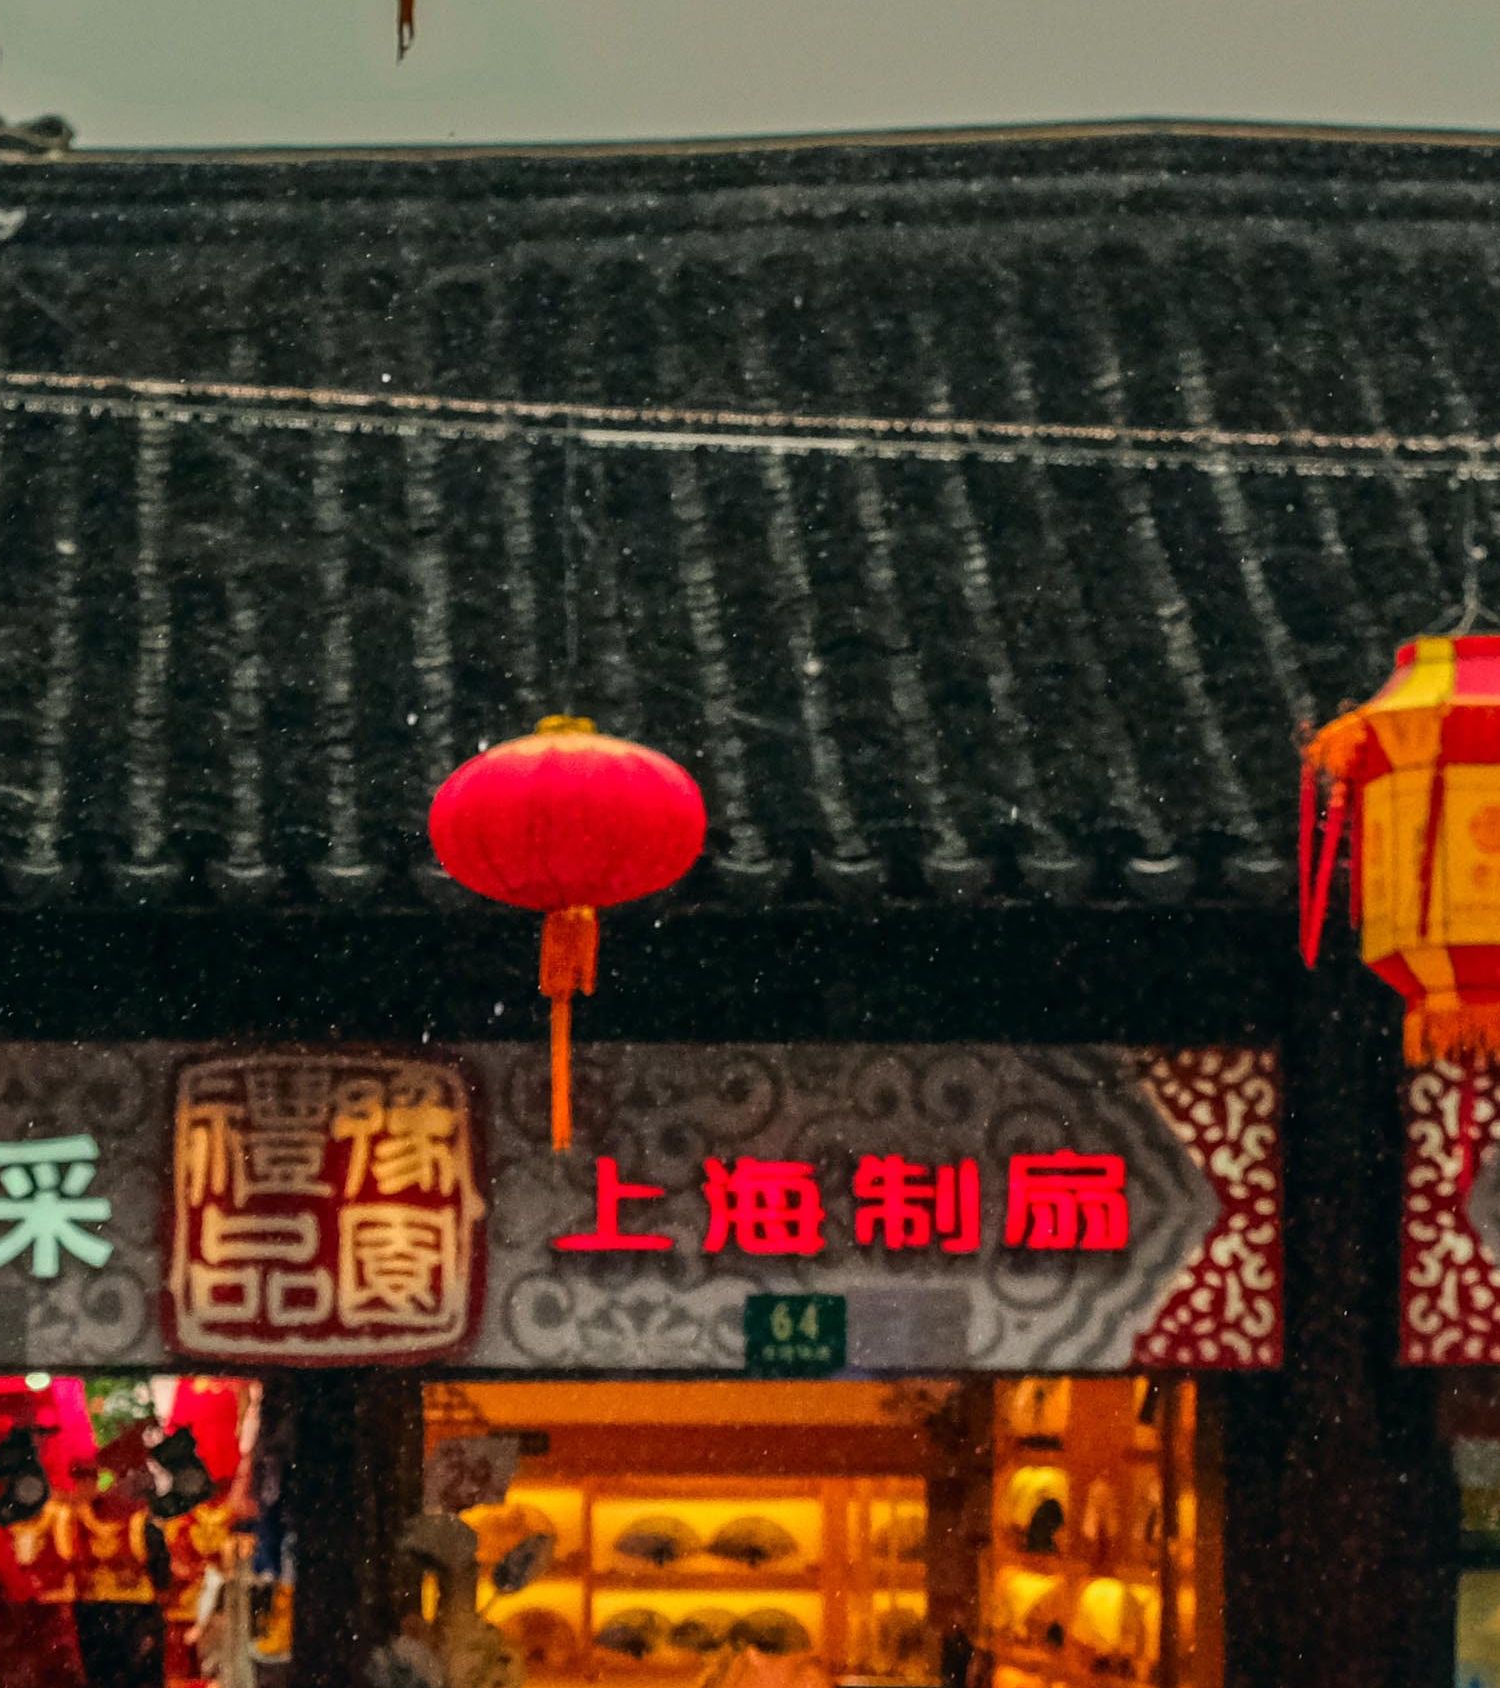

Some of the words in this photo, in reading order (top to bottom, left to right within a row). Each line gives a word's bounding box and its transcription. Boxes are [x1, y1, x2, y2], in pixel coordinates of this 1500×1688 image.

[552, 1150, 1129, 1255] 上海制扇
[770, 1302, 820, 1341] 64
